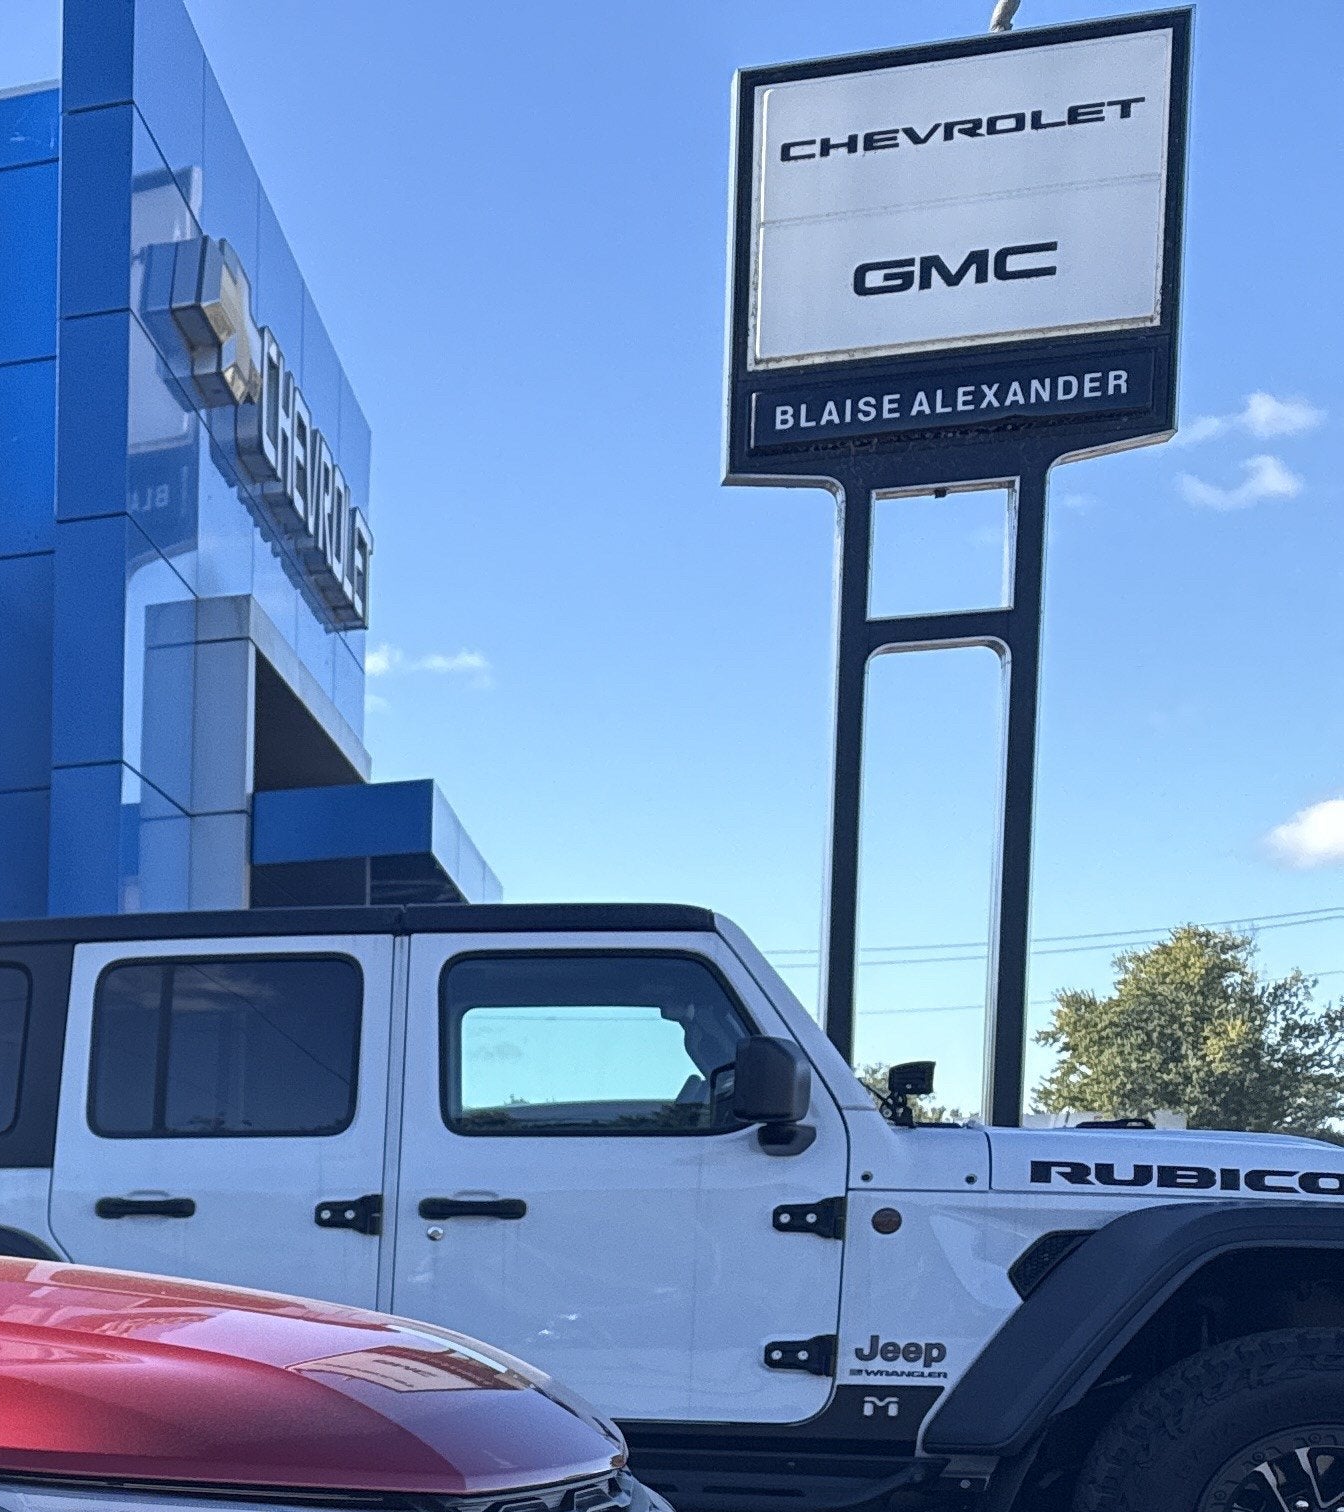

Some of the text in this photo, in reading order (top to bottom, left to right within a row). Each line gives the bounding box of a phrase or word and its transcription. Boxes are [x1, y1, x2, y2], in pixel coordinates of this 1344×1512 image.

[780, 96, 1146, 162] CHEVROLET
[853, 241, 1059, 297] GMC
[774, 369, 1129, 431] BLAISE ALEXANDER
[854, 1334, 947, 1369] Jeep
[863, 1369, 949, 1379] WRANGLER
